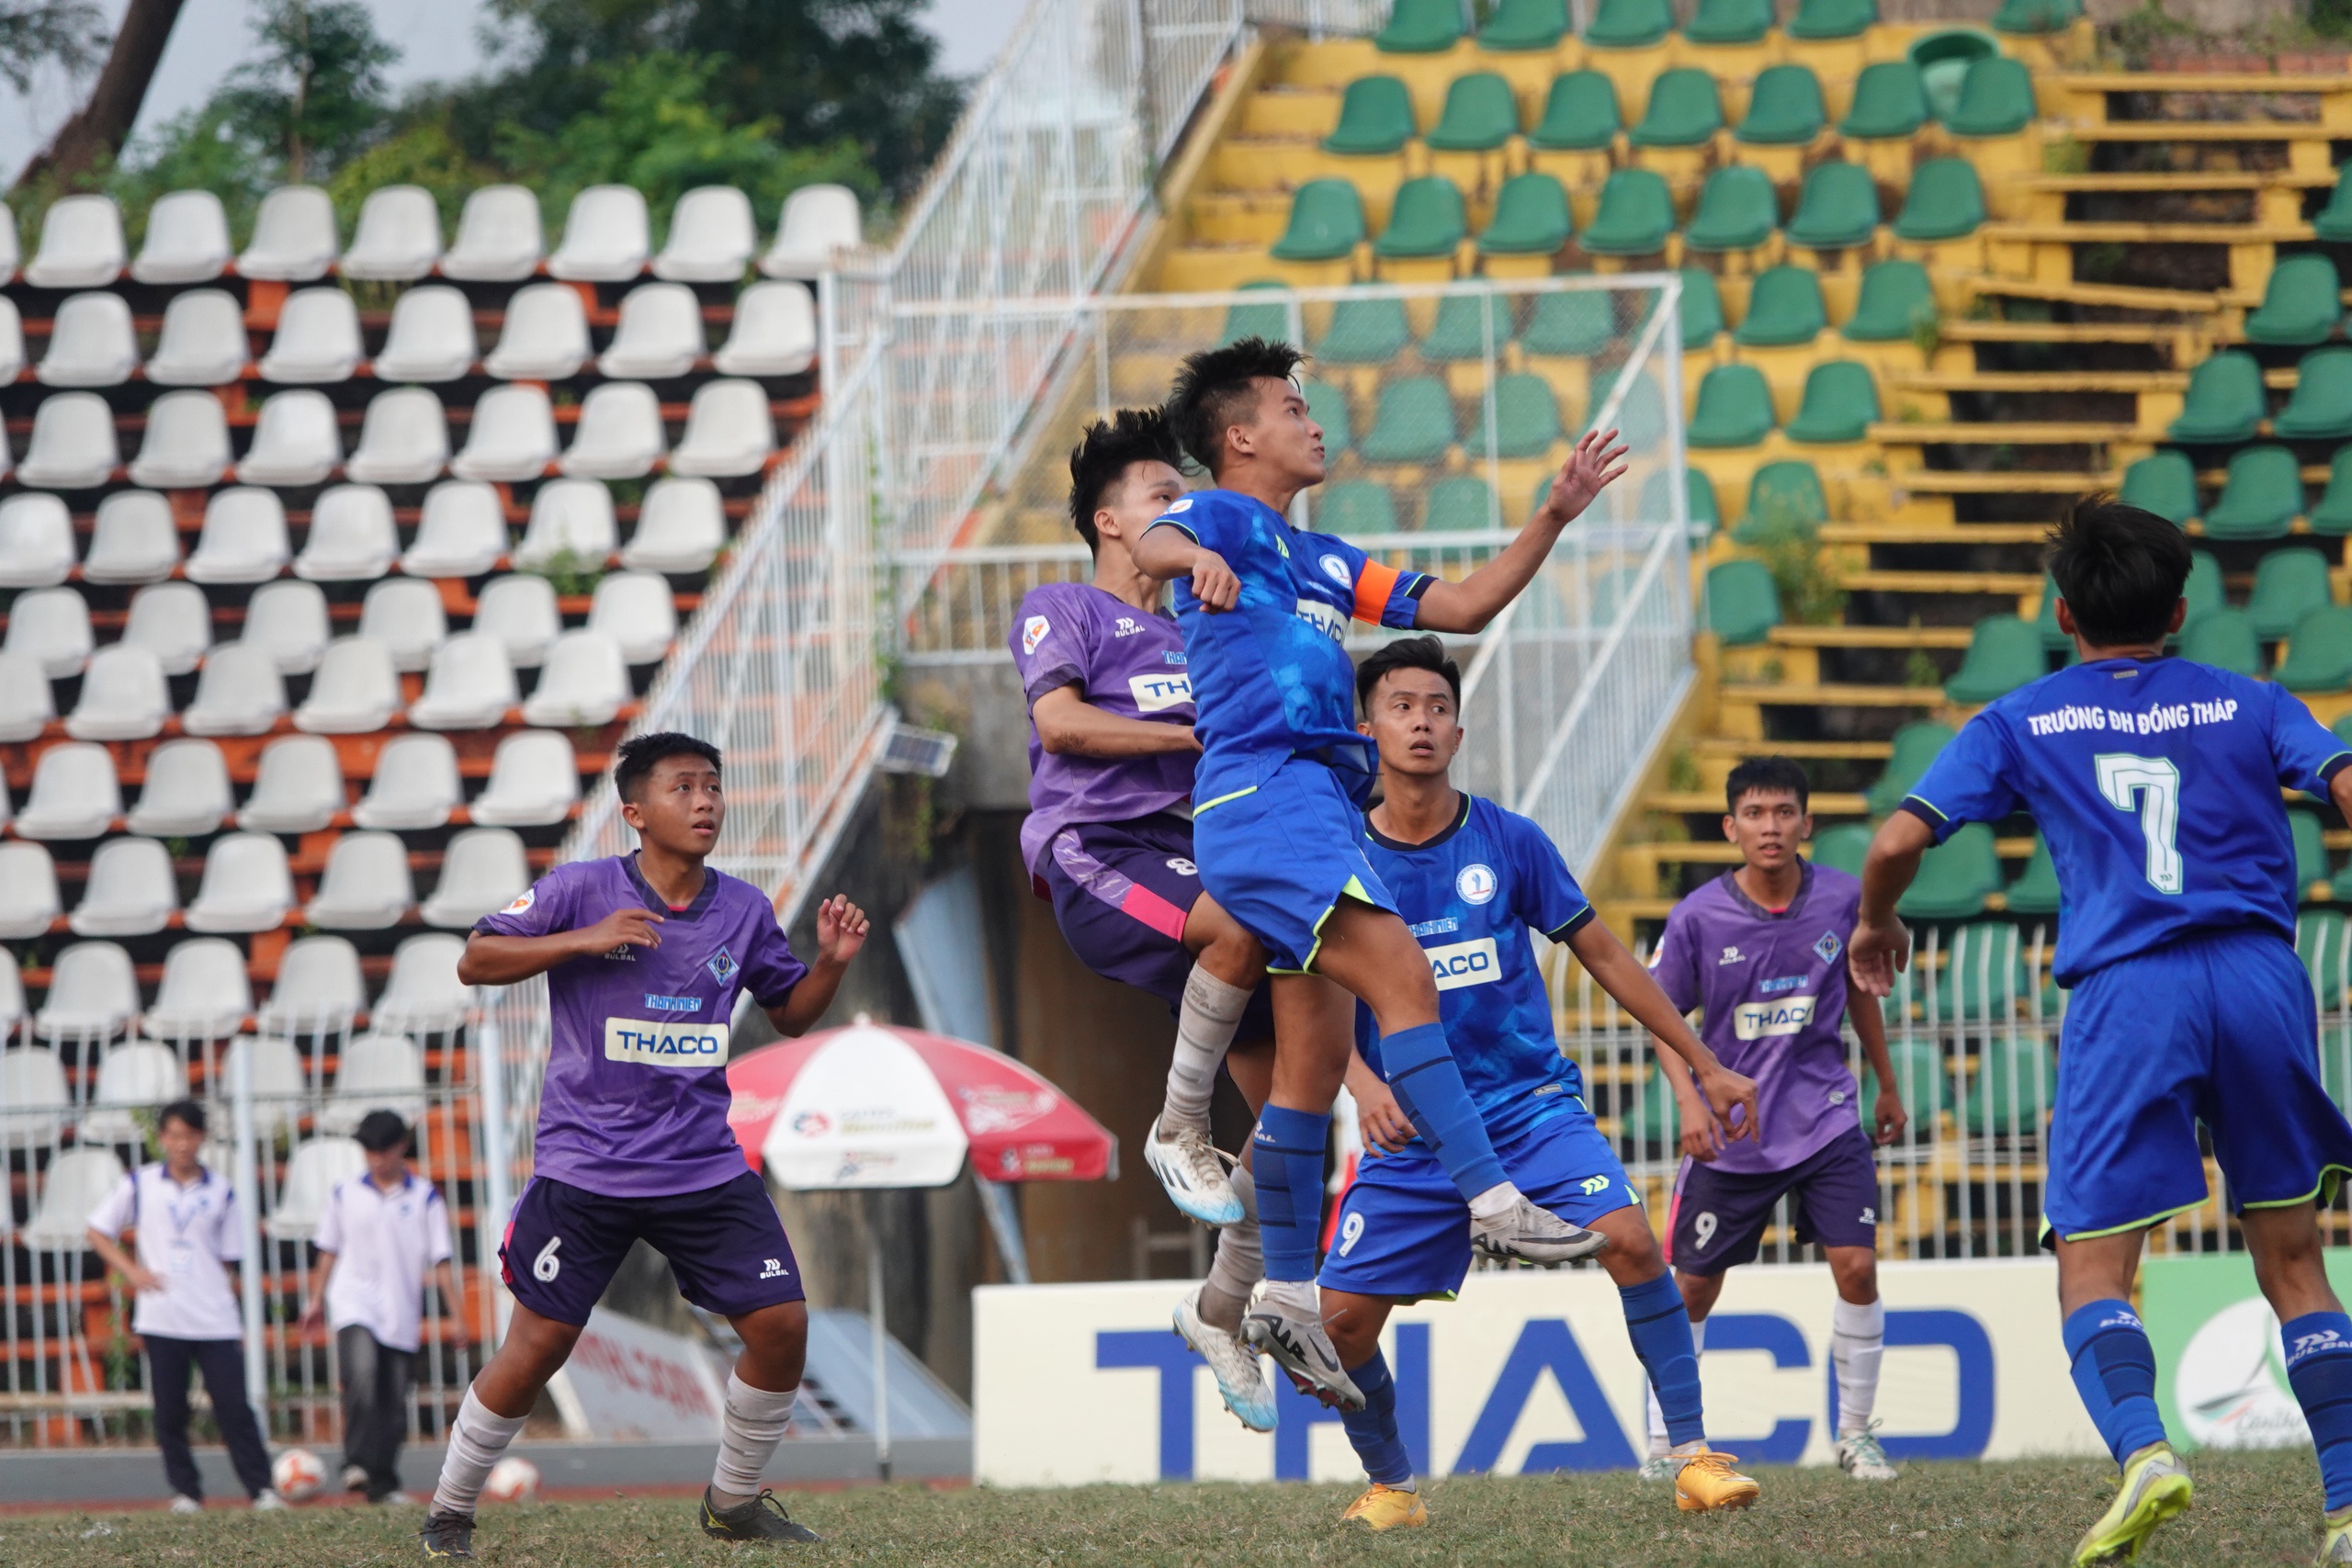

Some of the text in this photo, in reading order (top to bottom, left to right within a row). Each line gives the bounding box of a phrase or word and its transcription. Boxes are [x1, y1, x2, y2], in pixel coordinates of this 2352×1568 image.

[1114, 625, 1145, 638] BULBAL
[2028, 705, 2106, 736] TRƯỜNG
[2108, 709, 2135, 734] ĐH
[2136, 703, 2189, 735] ĐỒNG
[2094, 752, 2183, 895] 7
[1166, 857, 1198, 876] 8
[604, 953, 637, 962] BULBAL
[616, 1030, 718, 1055] THACO
[1339, 1211, 1365, 1258] 9
[1695, 1211, 1718, 1250] 9
[533, 1235, 562, 1283] 6
[759, 1269, 789, 1280] BULBAL
[2287, 1340, 2352, 1368] BULBA
[1096, 1308, 1996, 1481] THACO
